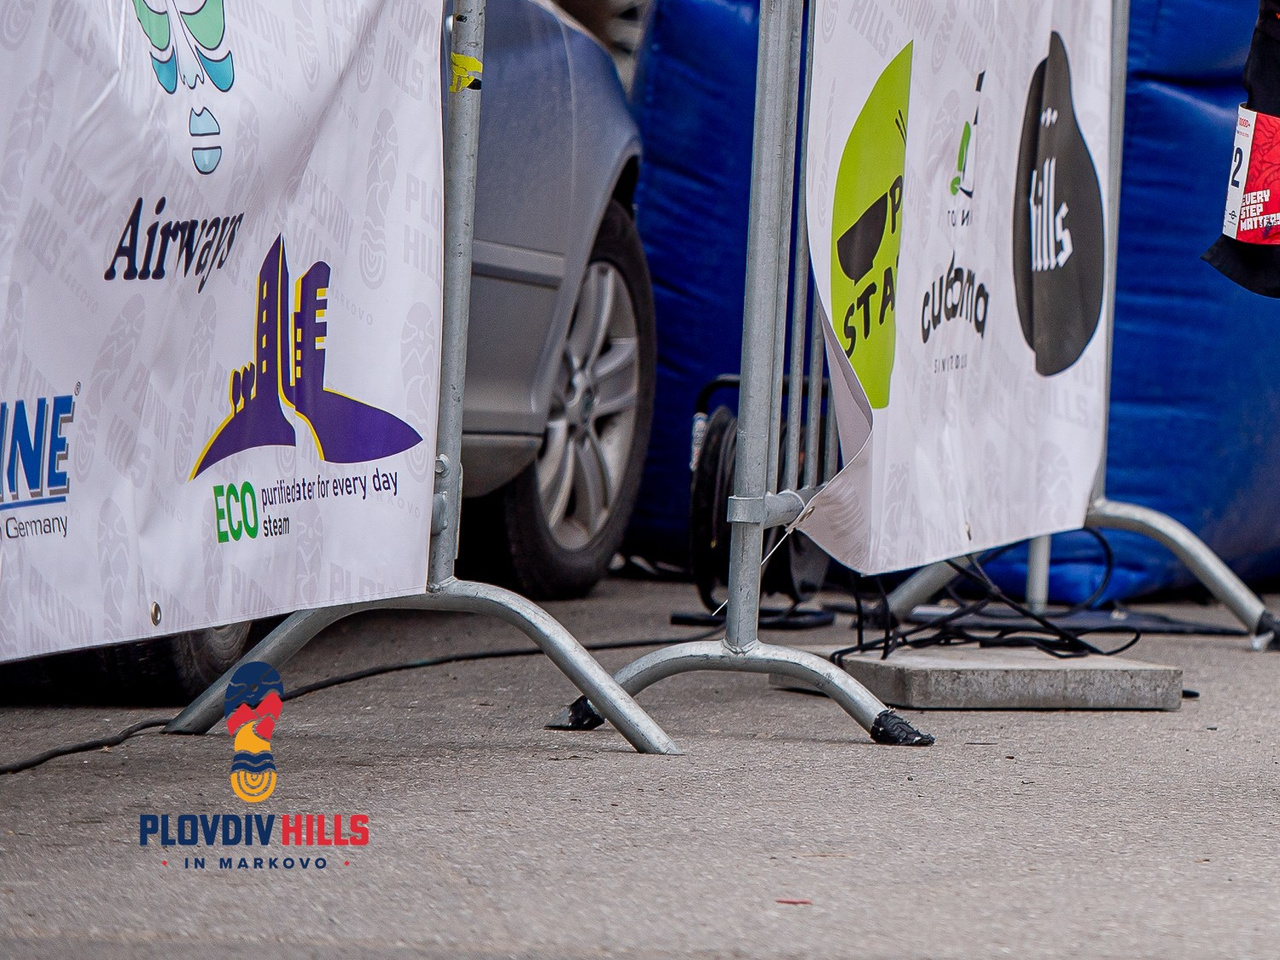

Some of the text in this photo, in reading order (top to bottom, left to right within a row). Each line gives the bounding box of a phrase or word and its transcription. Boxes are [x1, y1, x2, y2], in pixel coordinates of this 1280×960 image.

[1241, 189, 1271, 206] EVERY
[1240, 203, 1264, 220] STEP
[103, 196, 245, 294] Airways
[317, 474, 330, 499] for
[332, 475, 367, 500] every
[372, 467, 398, 496] day
[213, 481, 259, 544] ECO
[5, 515, 68, 539] Germany
[263, 516, 290, 538] steam
